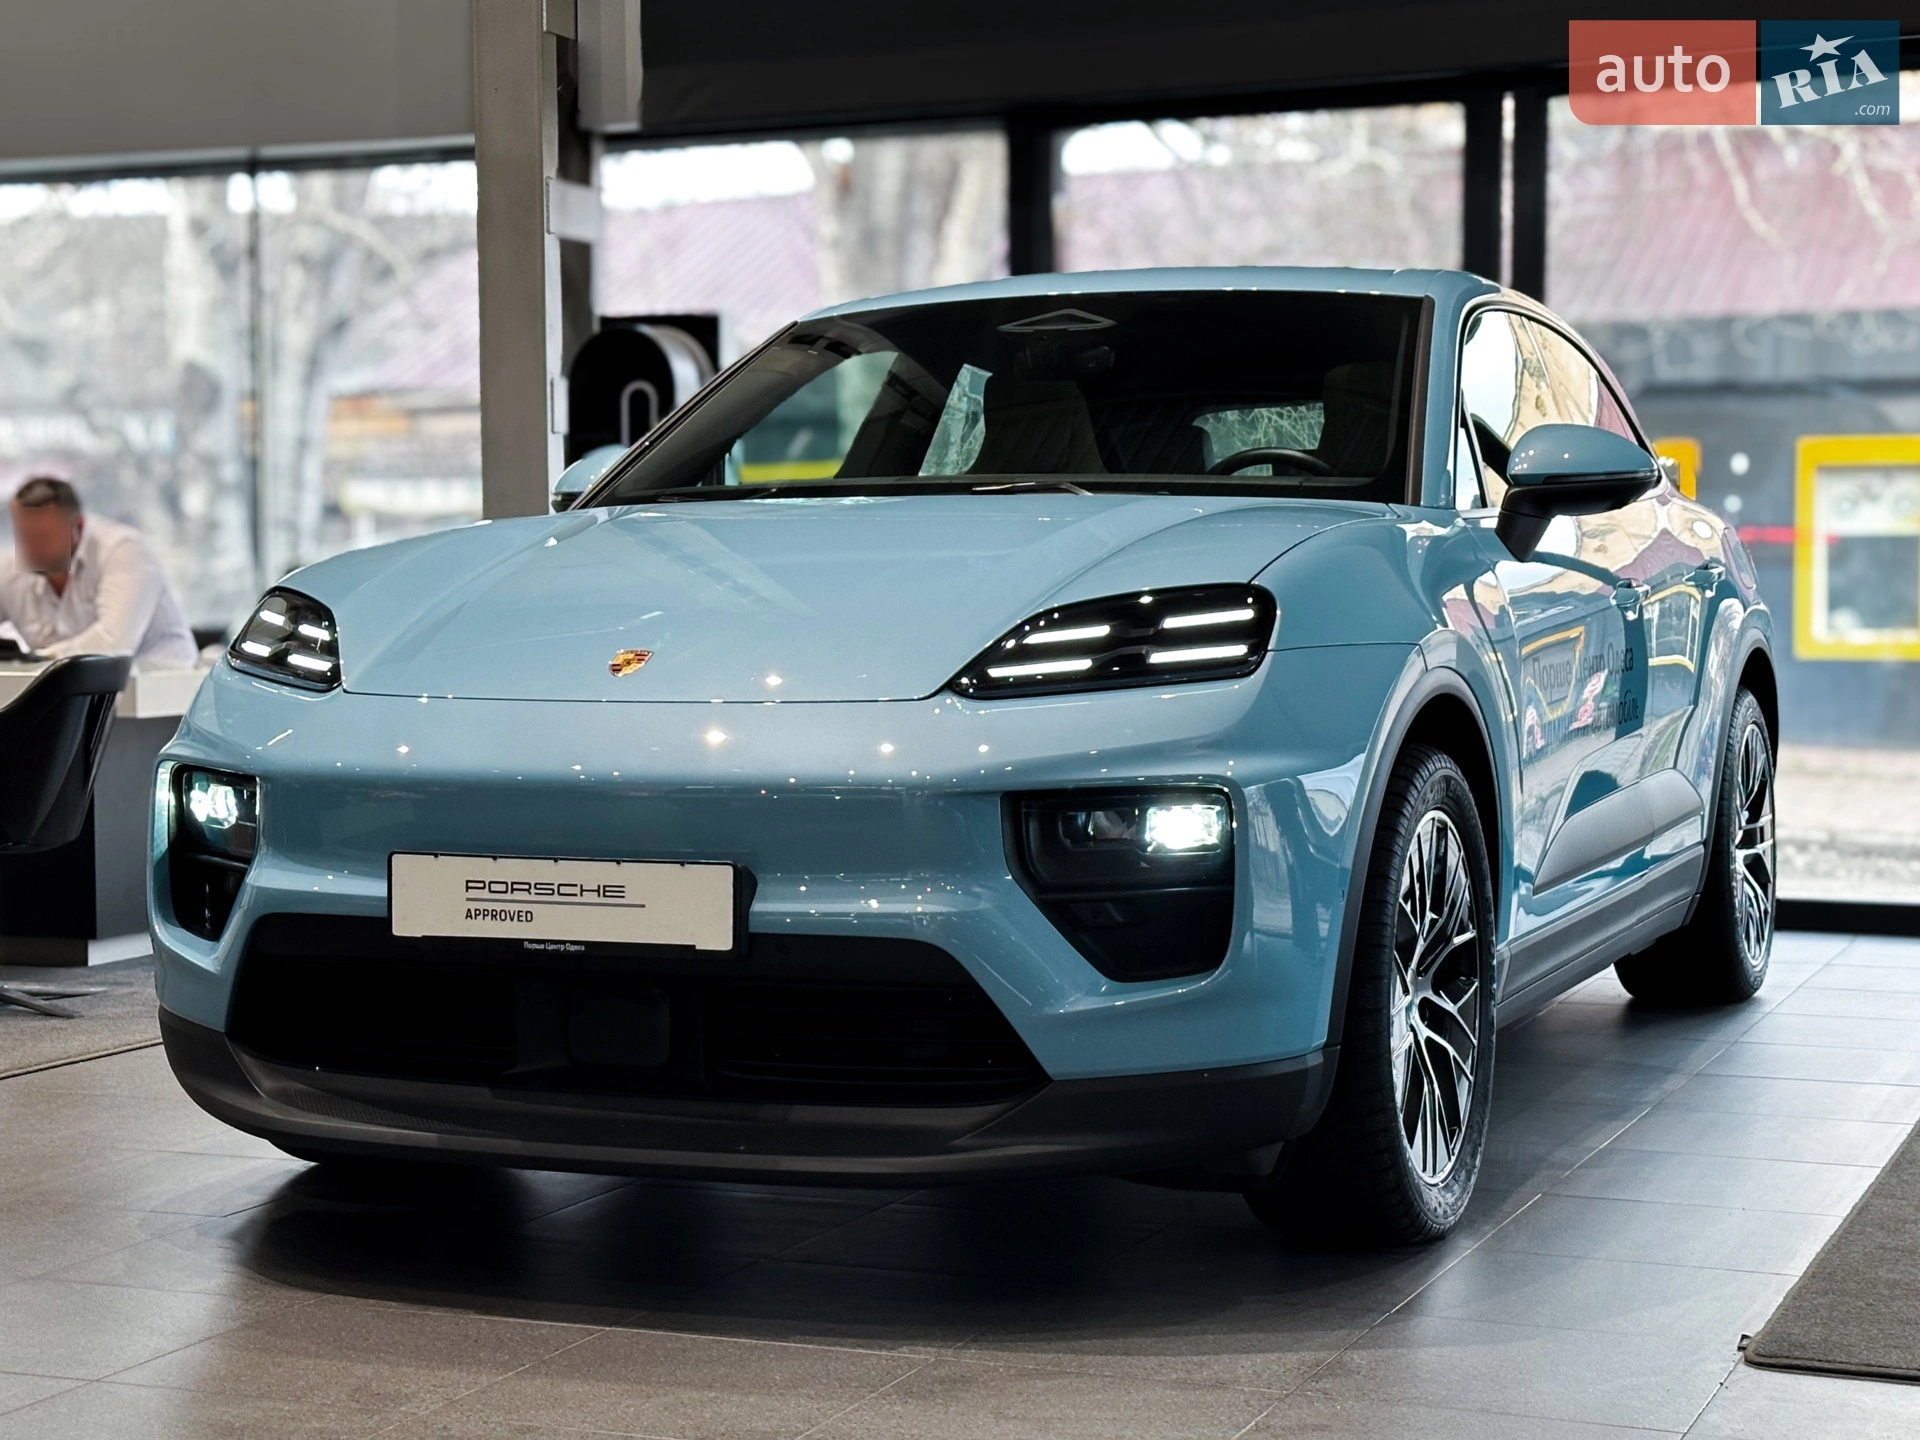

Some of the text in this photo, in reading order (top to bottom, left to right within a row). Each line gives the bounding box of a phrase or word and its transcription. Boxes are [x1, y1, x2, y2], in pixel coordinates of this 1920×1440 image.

[1532, 656, 1572, 702] Порше
[1607, 642, 1634, 682] Одеса
[465, 879, 626, 899] PORSCHE
[465, 907, 534, 923] APPROVED
[523, 941, 545, 950] Порше
[545, 942, 565, 951] Центр
